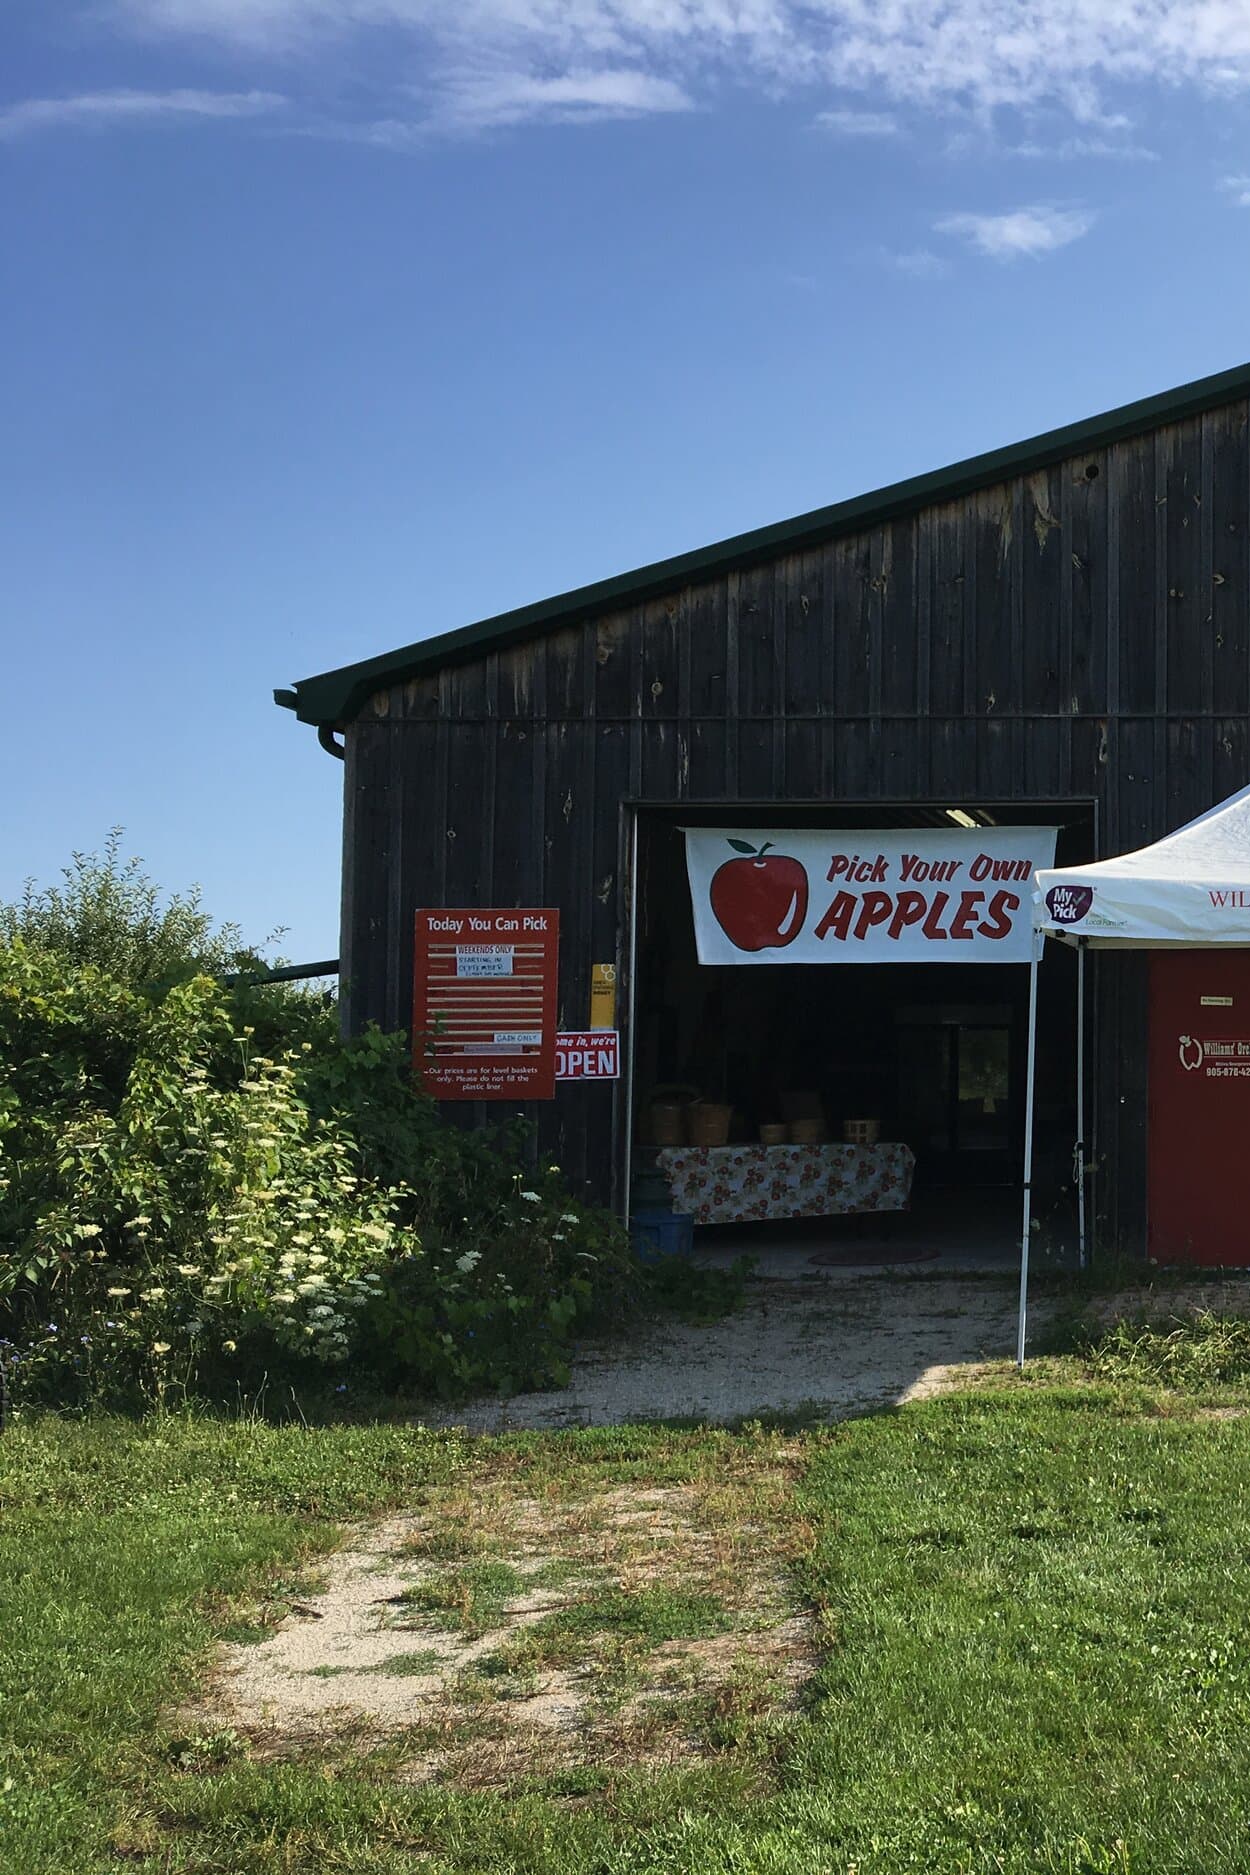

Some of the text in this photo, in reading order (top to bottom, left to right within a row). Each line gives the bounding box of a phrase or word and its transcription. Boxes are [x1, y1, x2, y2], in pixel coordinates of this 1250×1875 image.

[826, 853, 1033, 883] Pick Your Own
[1053, 888, 1073, 906] My
[814, 889, 1021, 941] APPLES
[1053, 903, 1077, 919] Pick
[427, 916, 548, 933] Today You Can Pick
[458, 945, 512, 954] WEEKENDS ONLY
[496, 1034, 537, 1042] CASH ONLY
[556, 1036, 616, 1047] me in, we're
[444, 1068, 464, 1076] prices
[480, 1066, 490, 1074] for
[492, 1066, 510, 1074] level
[512, 1066, 538, 1074] baskets
[555, 1050, 614, 1076] OPEN
[462, 1083, 484, 1092] plastic
